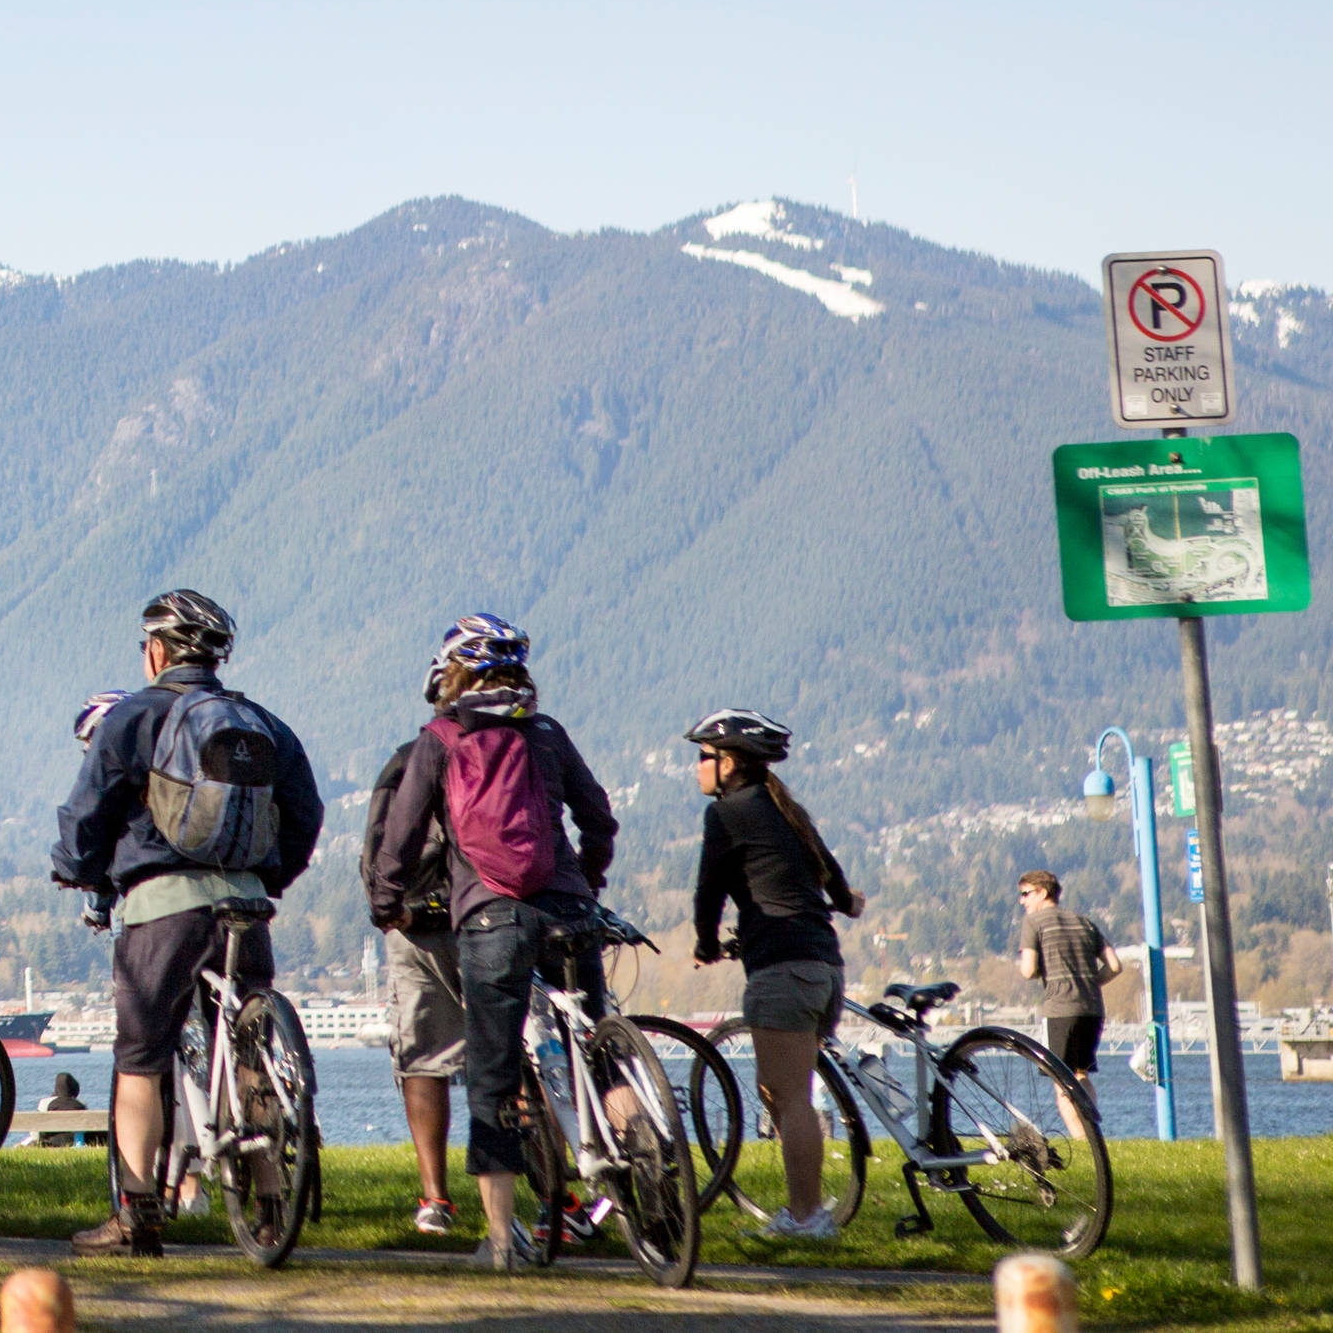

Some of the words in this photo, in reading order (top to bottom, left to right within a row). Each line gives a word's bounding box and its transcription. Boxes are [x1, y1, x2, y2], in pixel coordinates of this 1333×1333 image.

[1151, 282, 1187, 329] P
[1144, 346, 1195, 362] STAFF
[1134, 365, 1210, 382] PARKING
[1151, 387, 1194, 403] ONLY
[1077, 466, 1145, 480] Off-Leash
